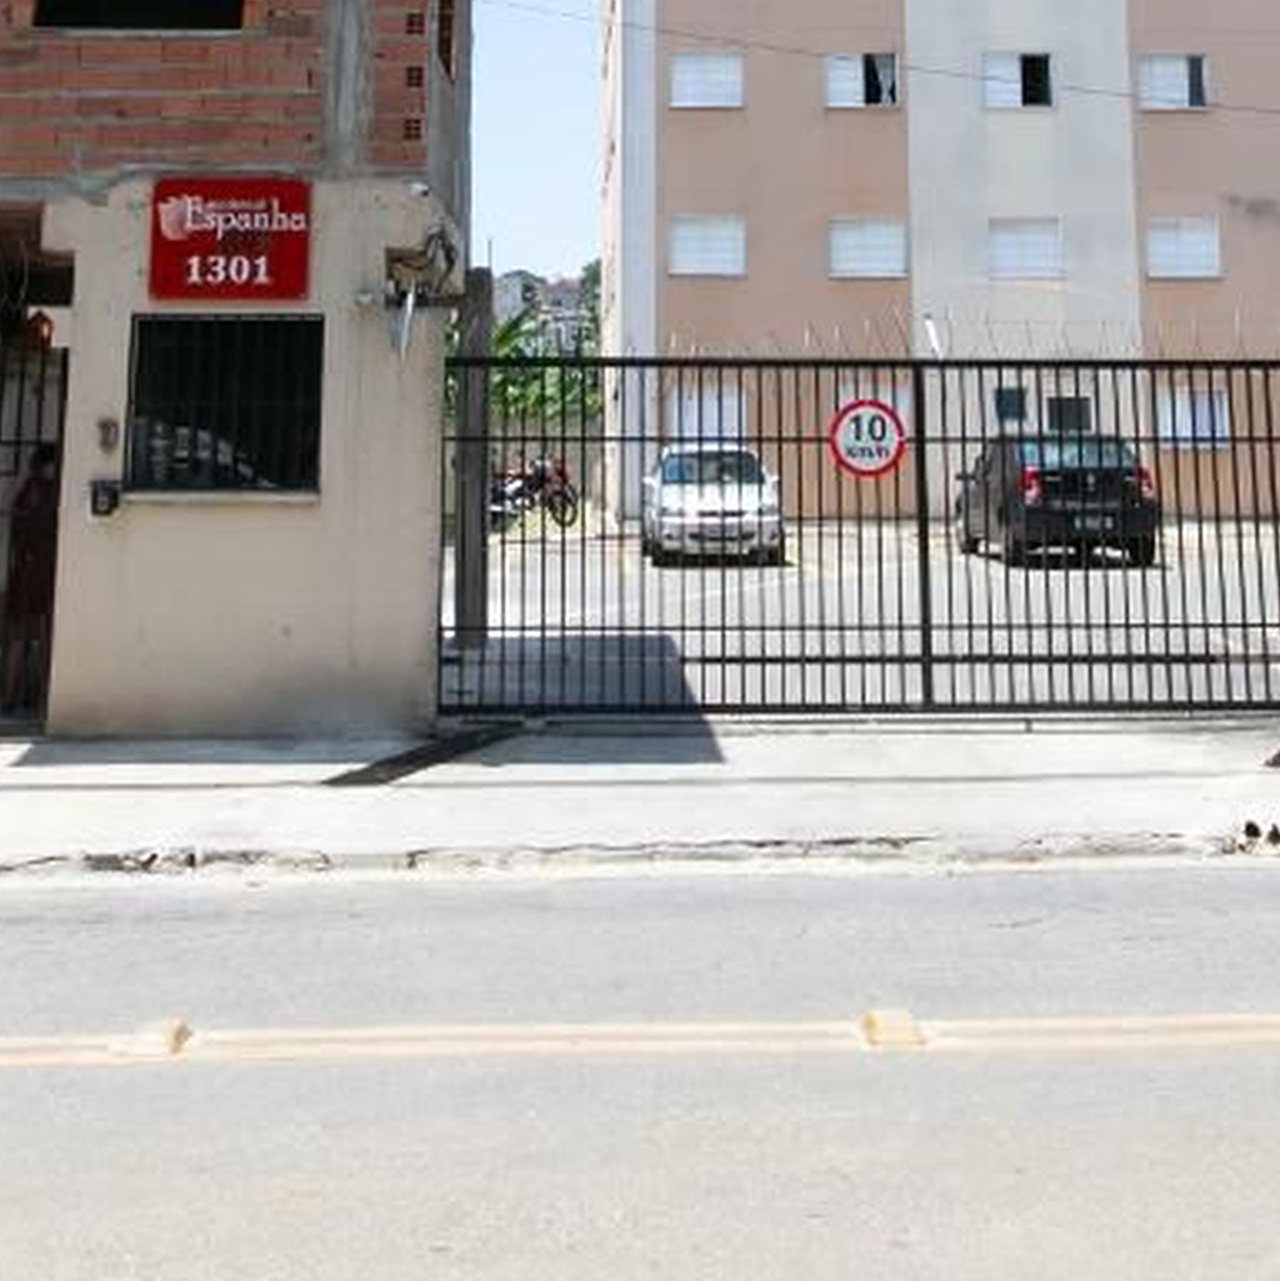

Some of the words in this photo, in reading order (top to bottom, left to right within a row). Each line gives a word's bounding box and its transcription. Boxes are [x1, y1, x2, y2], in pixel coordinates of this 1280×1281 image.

[182, 195, 308, 241] Espanha
[186, 255, 271, 285] 1301
[849, 413, 887, 442] 10
